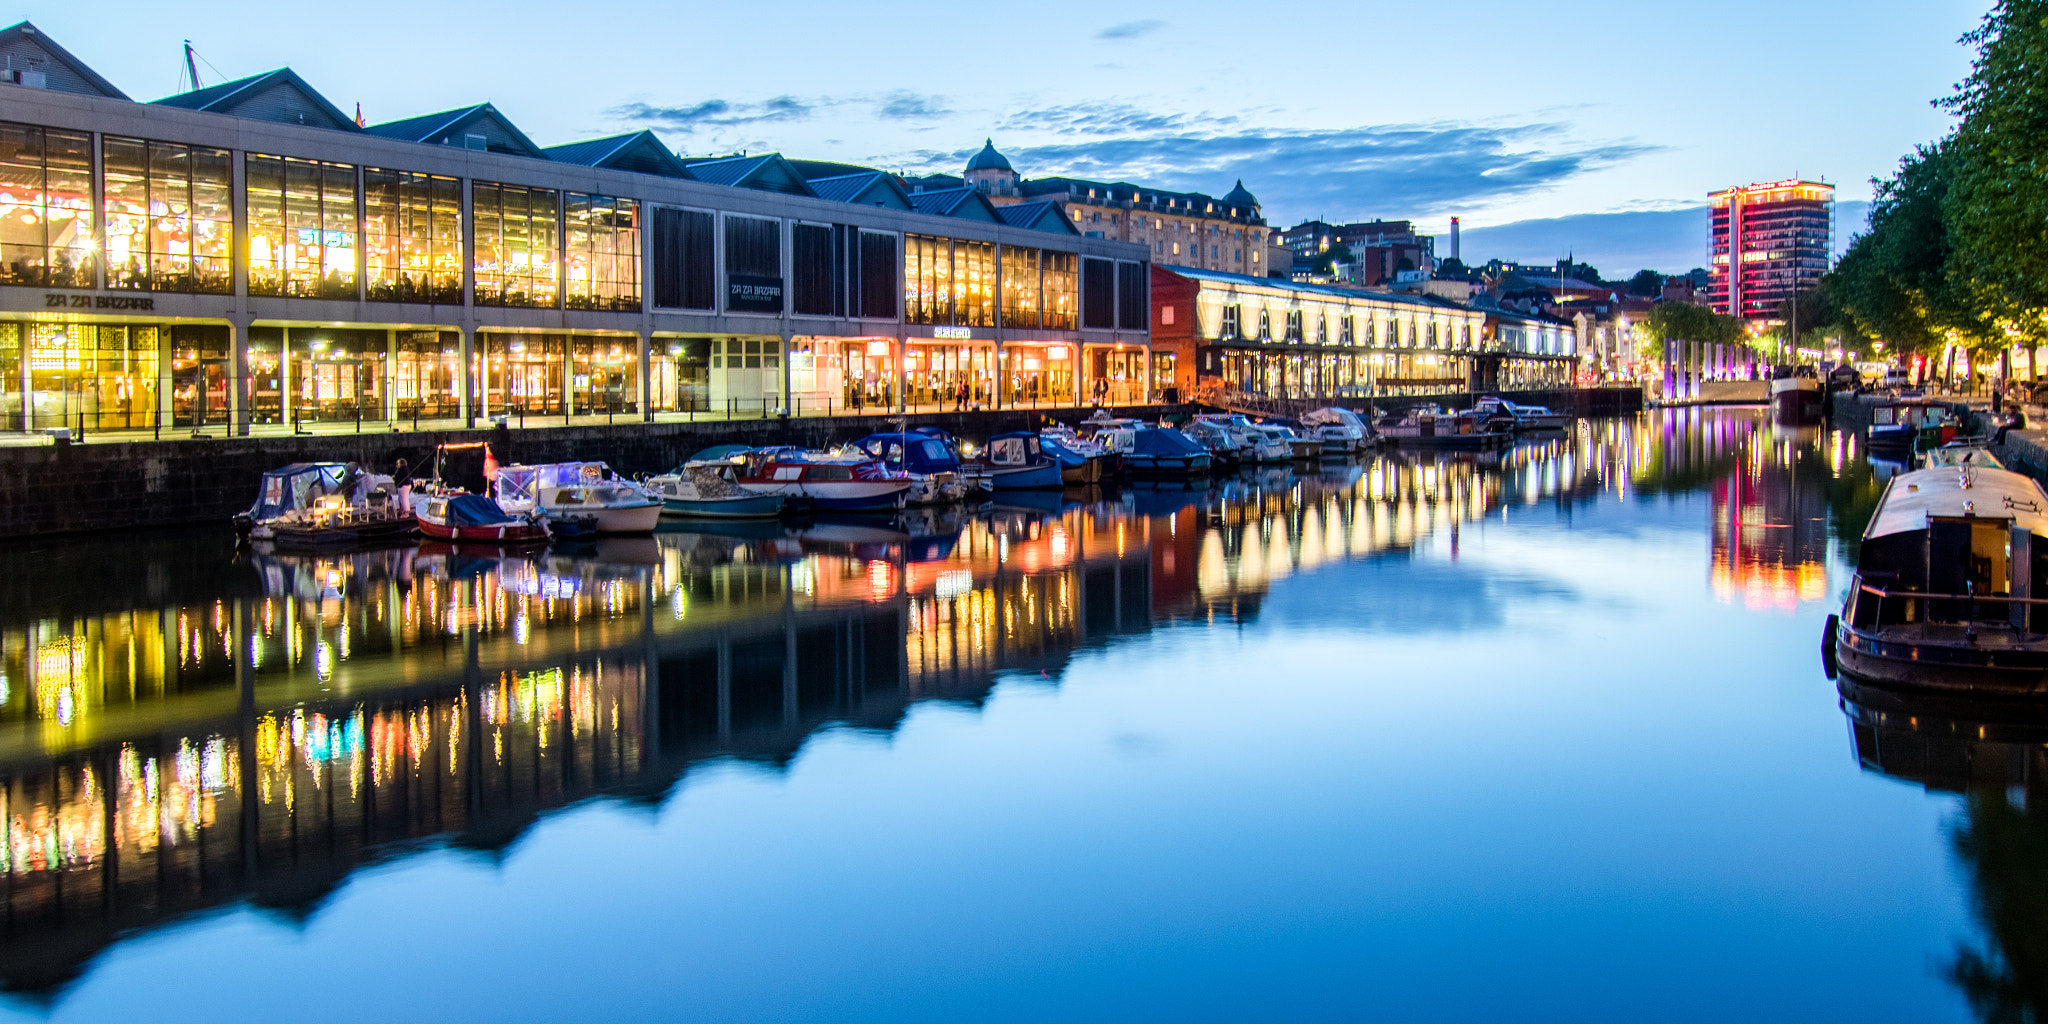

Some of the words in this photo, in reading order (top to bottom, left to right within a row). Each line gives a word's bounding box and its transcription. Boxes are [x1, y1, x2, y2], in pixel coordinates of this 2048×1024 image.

[1747, 183, 1775, 191] COLSTON
[731, 284, 742, 294] ZA
[743, 285, 753, 295] ZA
[754, 285, 781, 296] BAZAAR
[45, 294, 67, 307] ZA
[70, 295, 92, 308] ZA
[95, 296, 155, 310] BAZAAR
